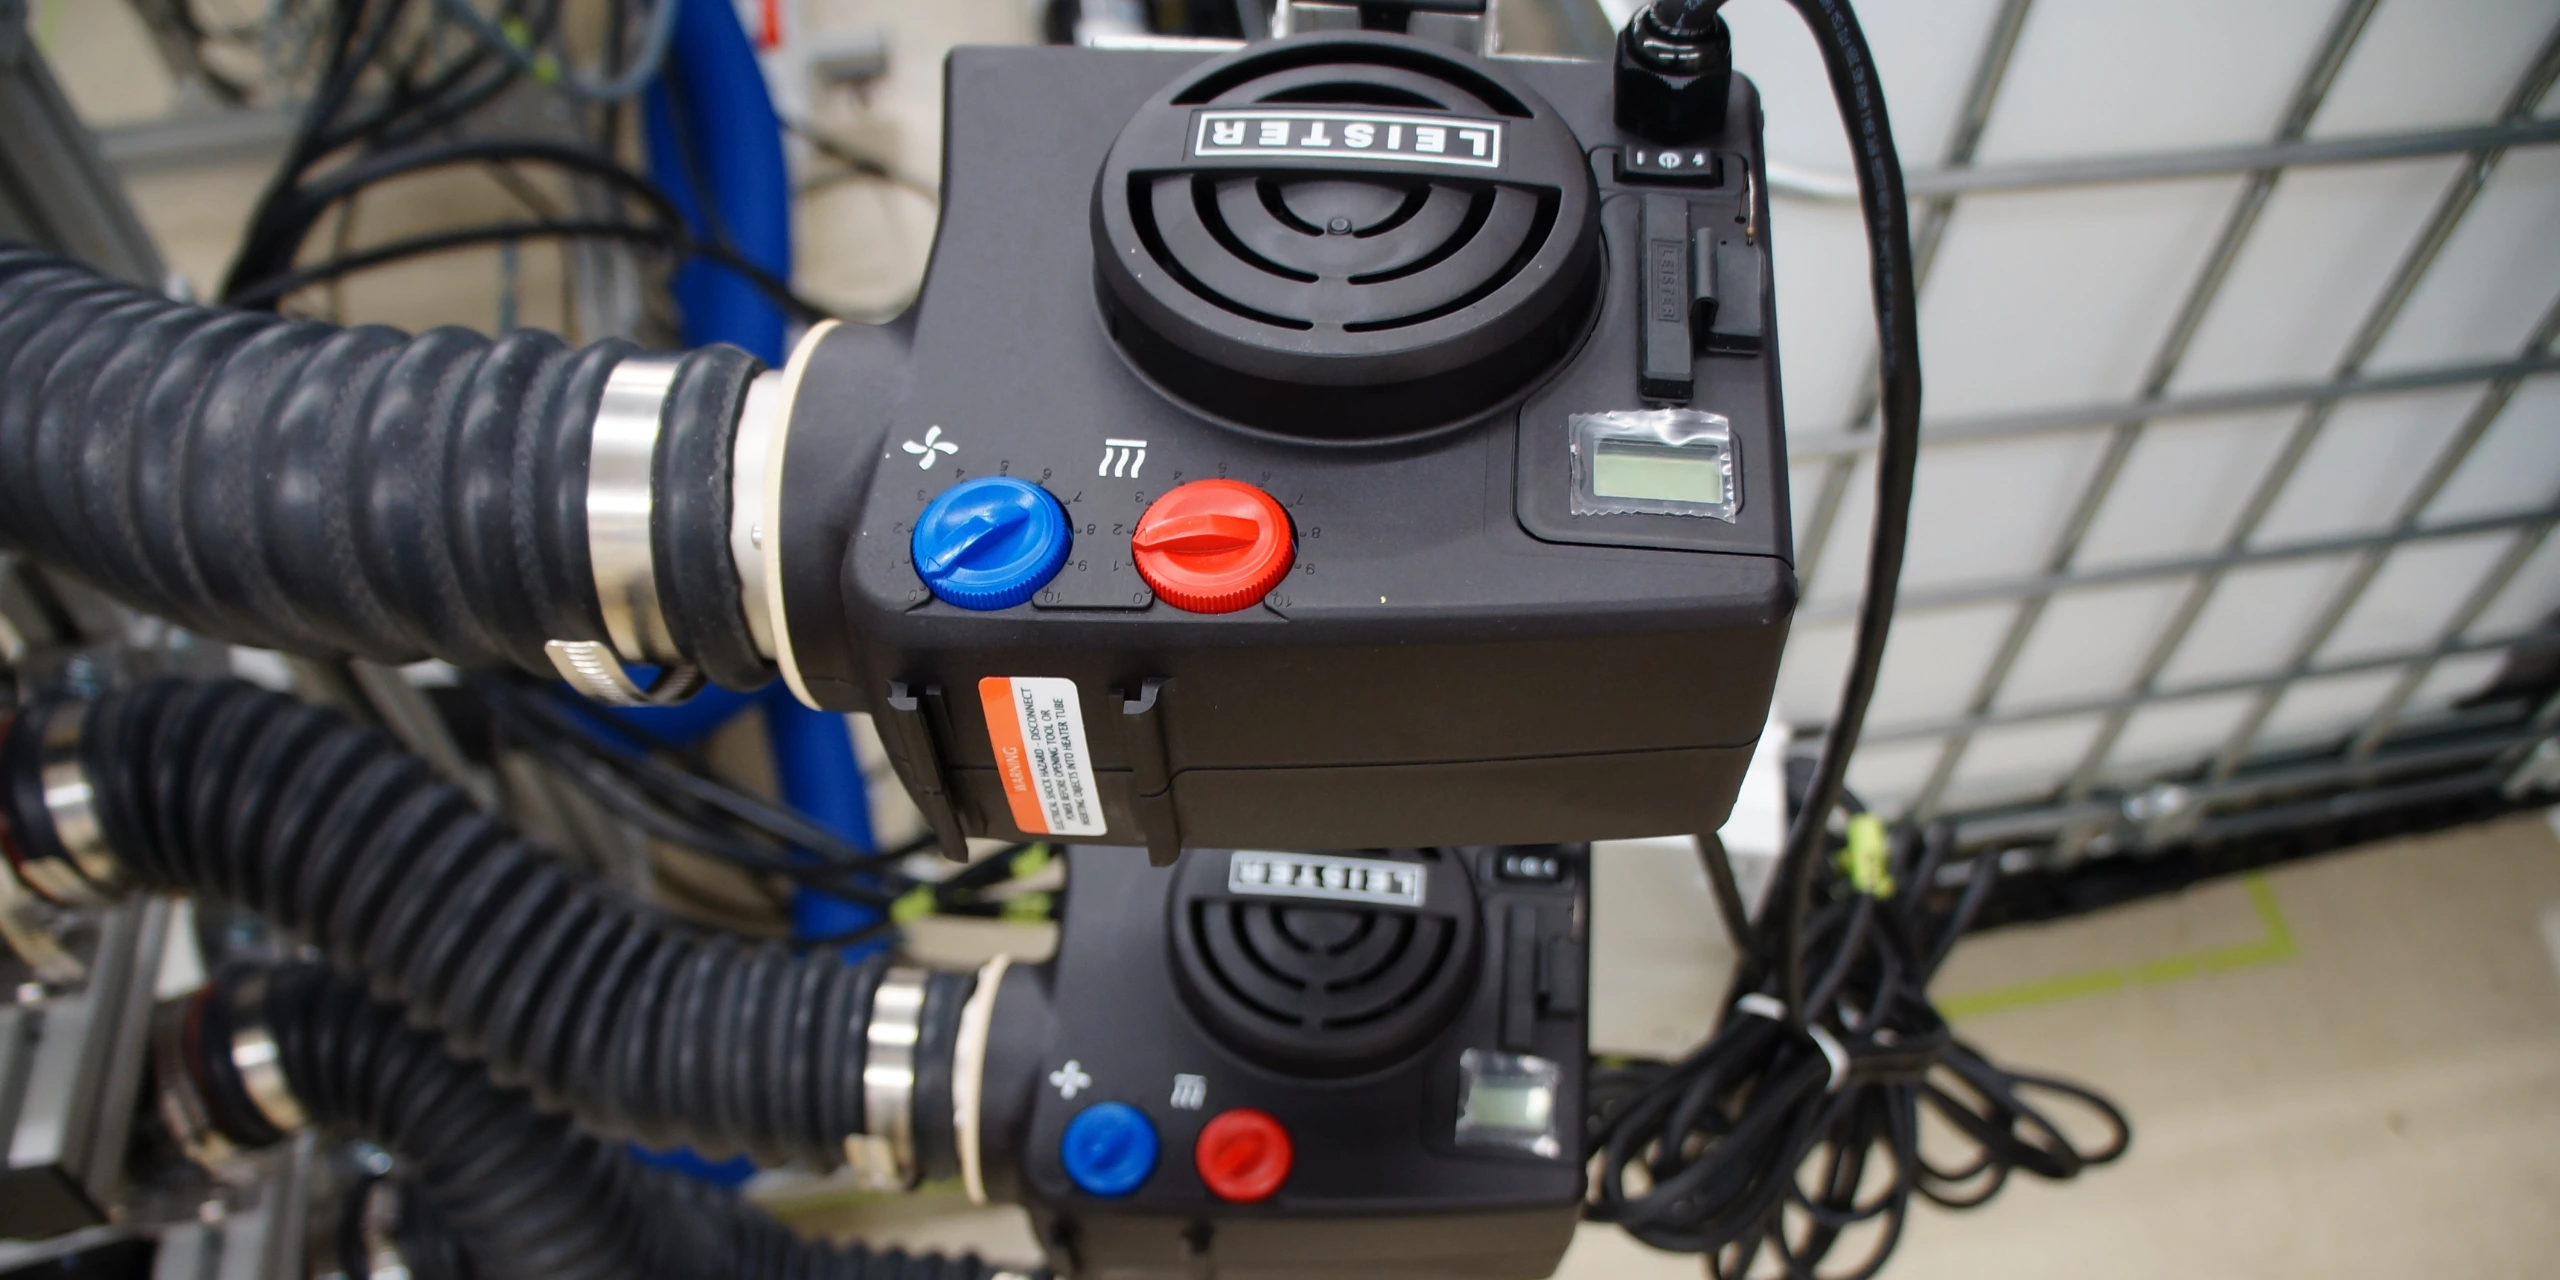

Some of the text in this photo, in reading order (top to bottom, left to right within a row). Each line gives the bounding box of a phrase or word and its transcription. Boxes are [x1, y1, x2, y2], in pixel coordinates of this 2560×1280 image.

[1212, 120, 1487, 157] LEISTER
[1661, 249, 1675, 318] LEISTER
[1072, 491, 1082, 503] 7
[1134, 491, 1144, 503] 3
[1087, 524, 1096, 535] 8
[1112, 523, 1123, 536] 2
[1311, 527, 1321, 539] 8
[1078, 560, 1087, 572] 9
[1305, 563, 1315, 576] 9
[1021, 687, 1041, 740] DISCONNECT
[1053, 698, 1065, 718] TUBE
[1057, 722, 1072, 750] HEATER
[1002, 746, 1027, 792] WARNING
[1034, 748, 1049, 777] HAZARD
[1040, 709, 1075, 820] POWER BEFORE OPENING TOOL OR
[1064, 753, 1076, 769] INTO
[1042, 779, 1056, 799] SHOCK
[1068, 772, 1084, 797] OBJECTS
[1239, 863, 1414, 895] LEISTER
